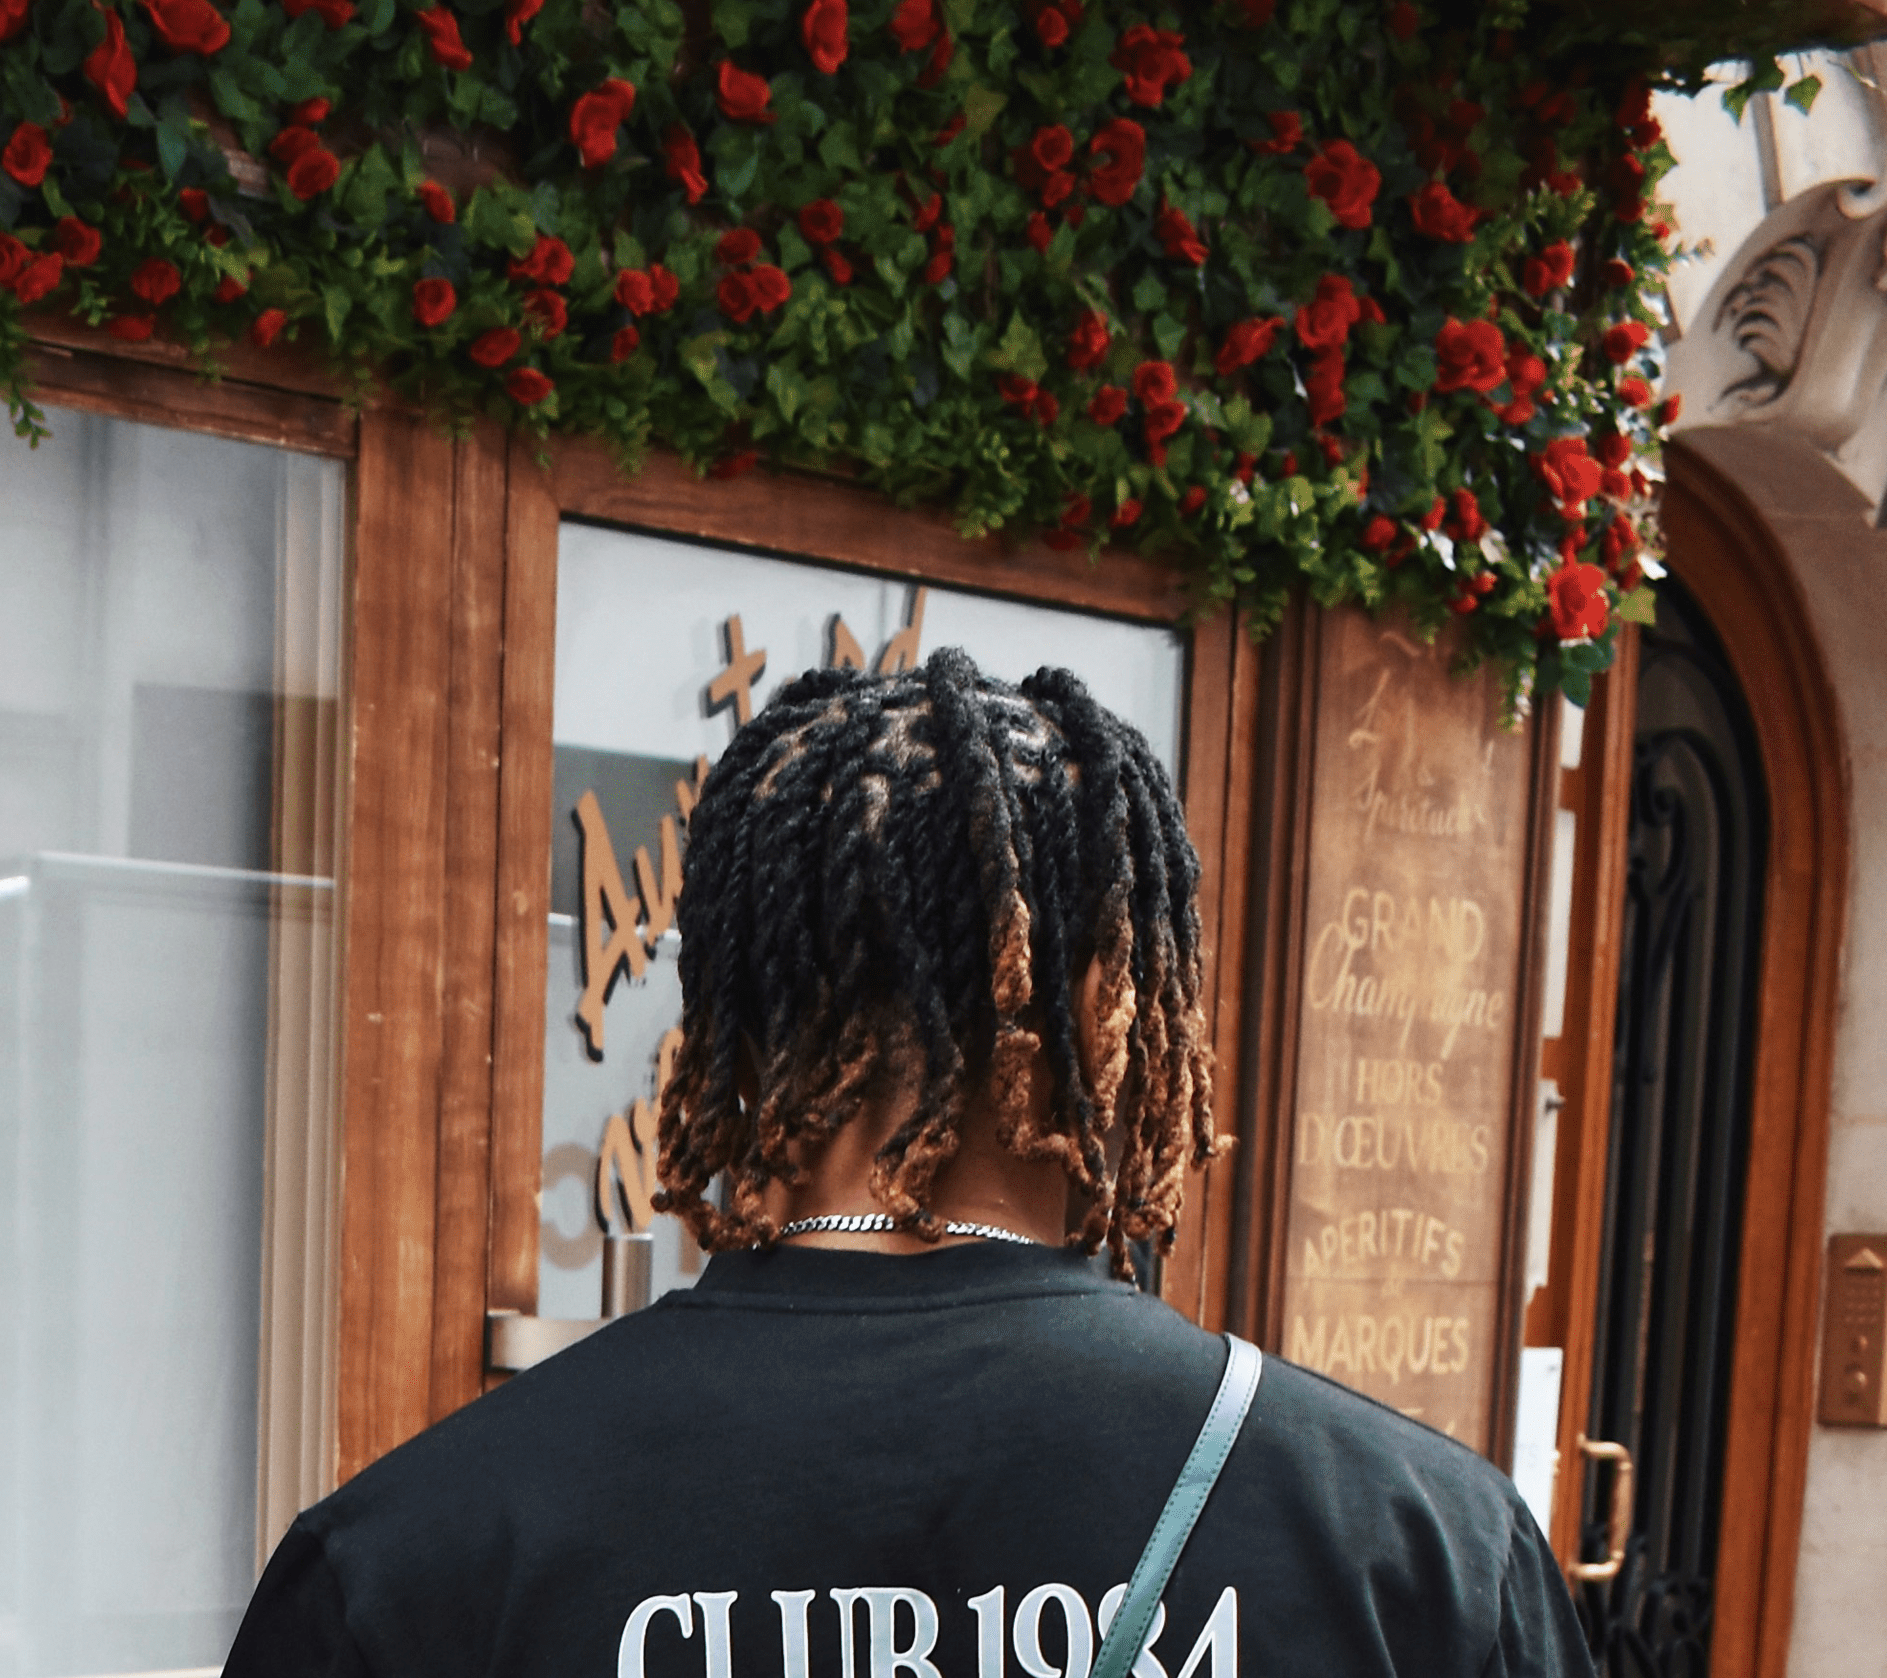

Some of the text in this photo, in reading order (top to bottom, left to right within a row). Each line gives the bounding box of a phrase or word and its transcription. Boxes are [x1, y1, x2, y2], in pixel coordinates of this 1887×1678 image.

[1342, 887, 1487, 964] GRAND
[1355, 1056, 1444, 1106] HORS
[1290, 1313, 1472, 1385] MARQUES
